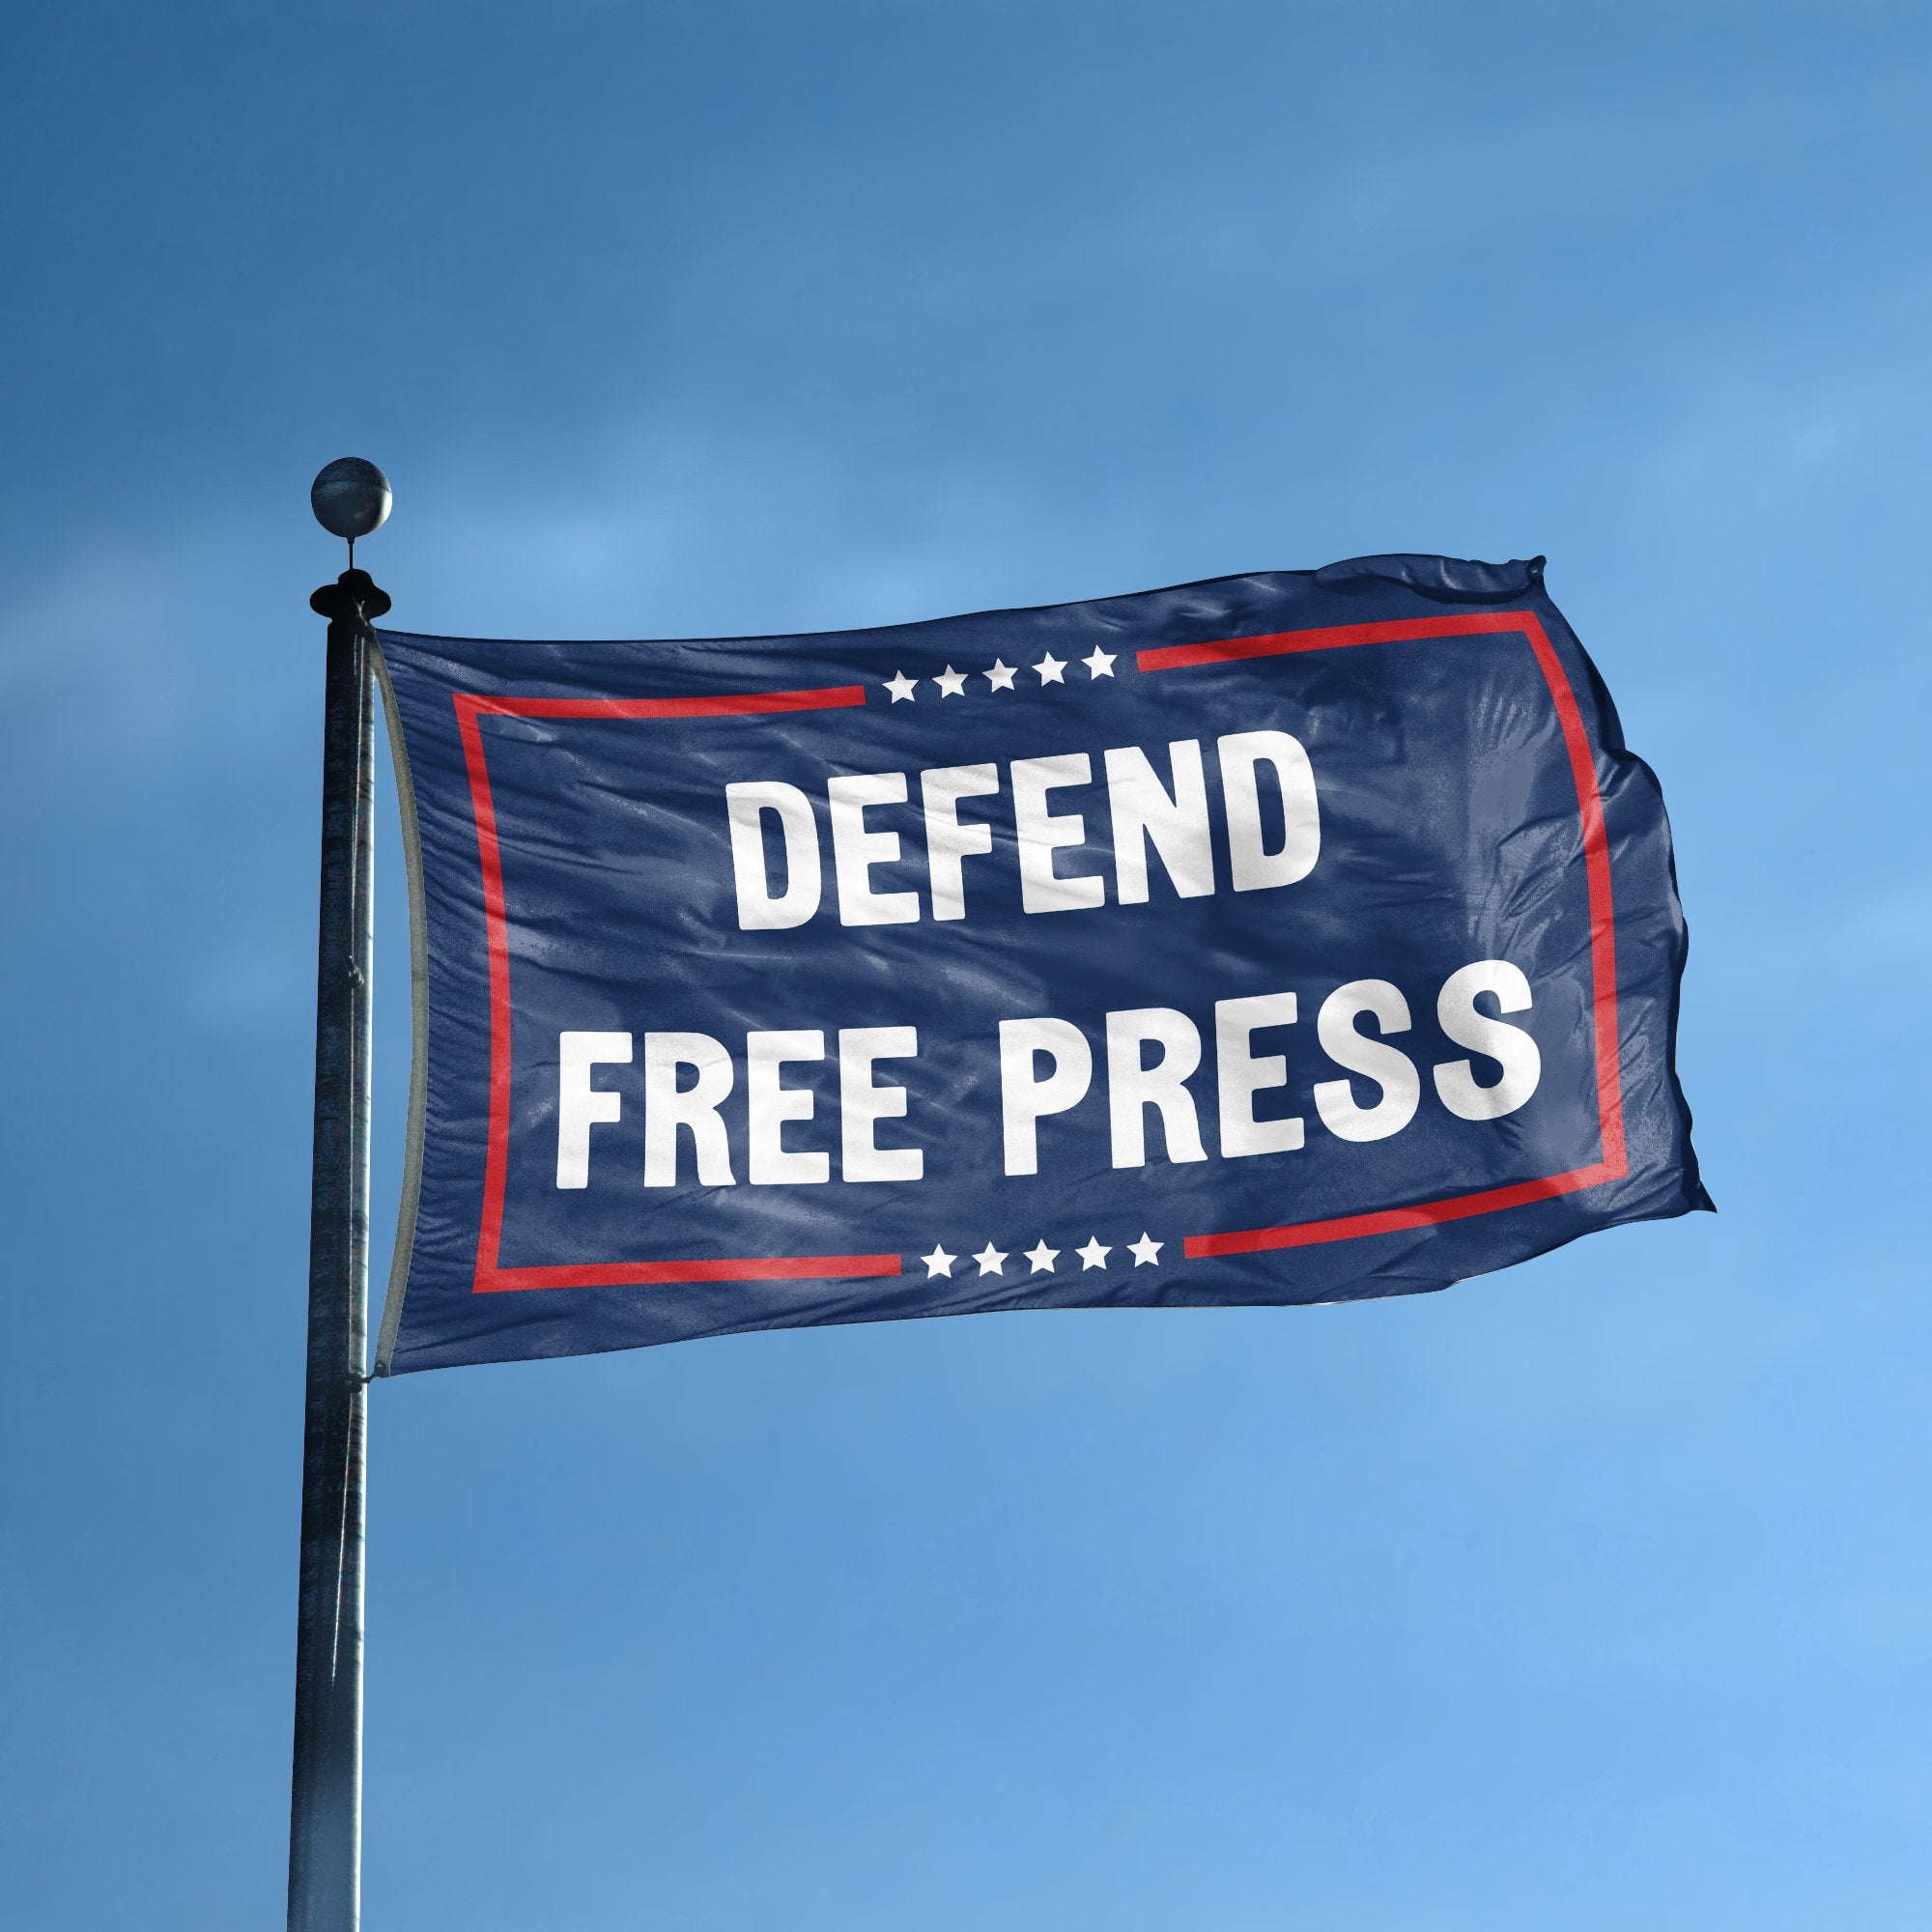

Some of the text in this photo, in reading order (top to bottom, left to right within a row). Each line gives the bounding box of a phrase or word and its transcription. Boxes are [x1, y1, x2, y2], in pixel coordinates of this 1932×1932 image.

[724, 729, 1321, 931] DEFEND
[555, 959, 1542, 1190] FREE PRESS
